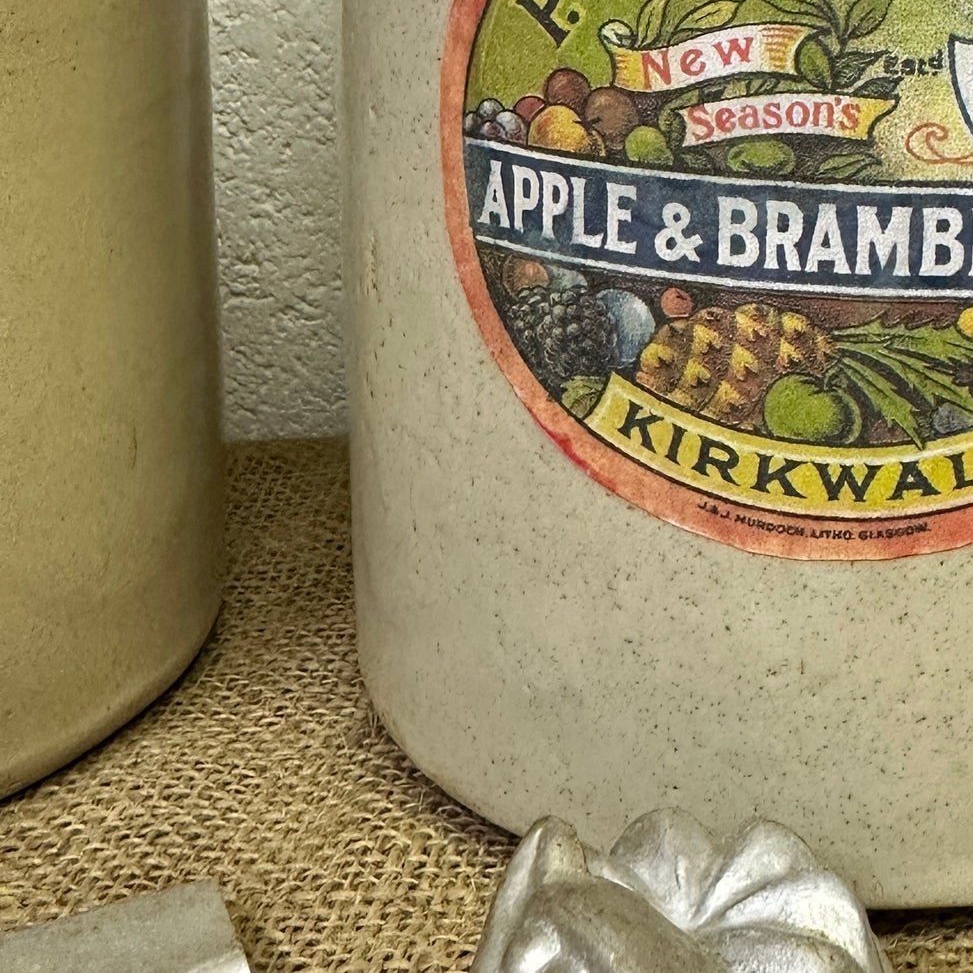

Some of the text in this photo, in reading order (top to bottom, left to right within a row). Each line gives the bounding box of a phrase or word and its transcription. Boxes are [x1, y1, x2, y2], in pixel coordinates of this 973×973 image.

[641, 36, 754, 90] New
[687, 96, 861, 142] Season's
[477, 159, 638, 255] APPLE
[654, 202, 704, 262] &
